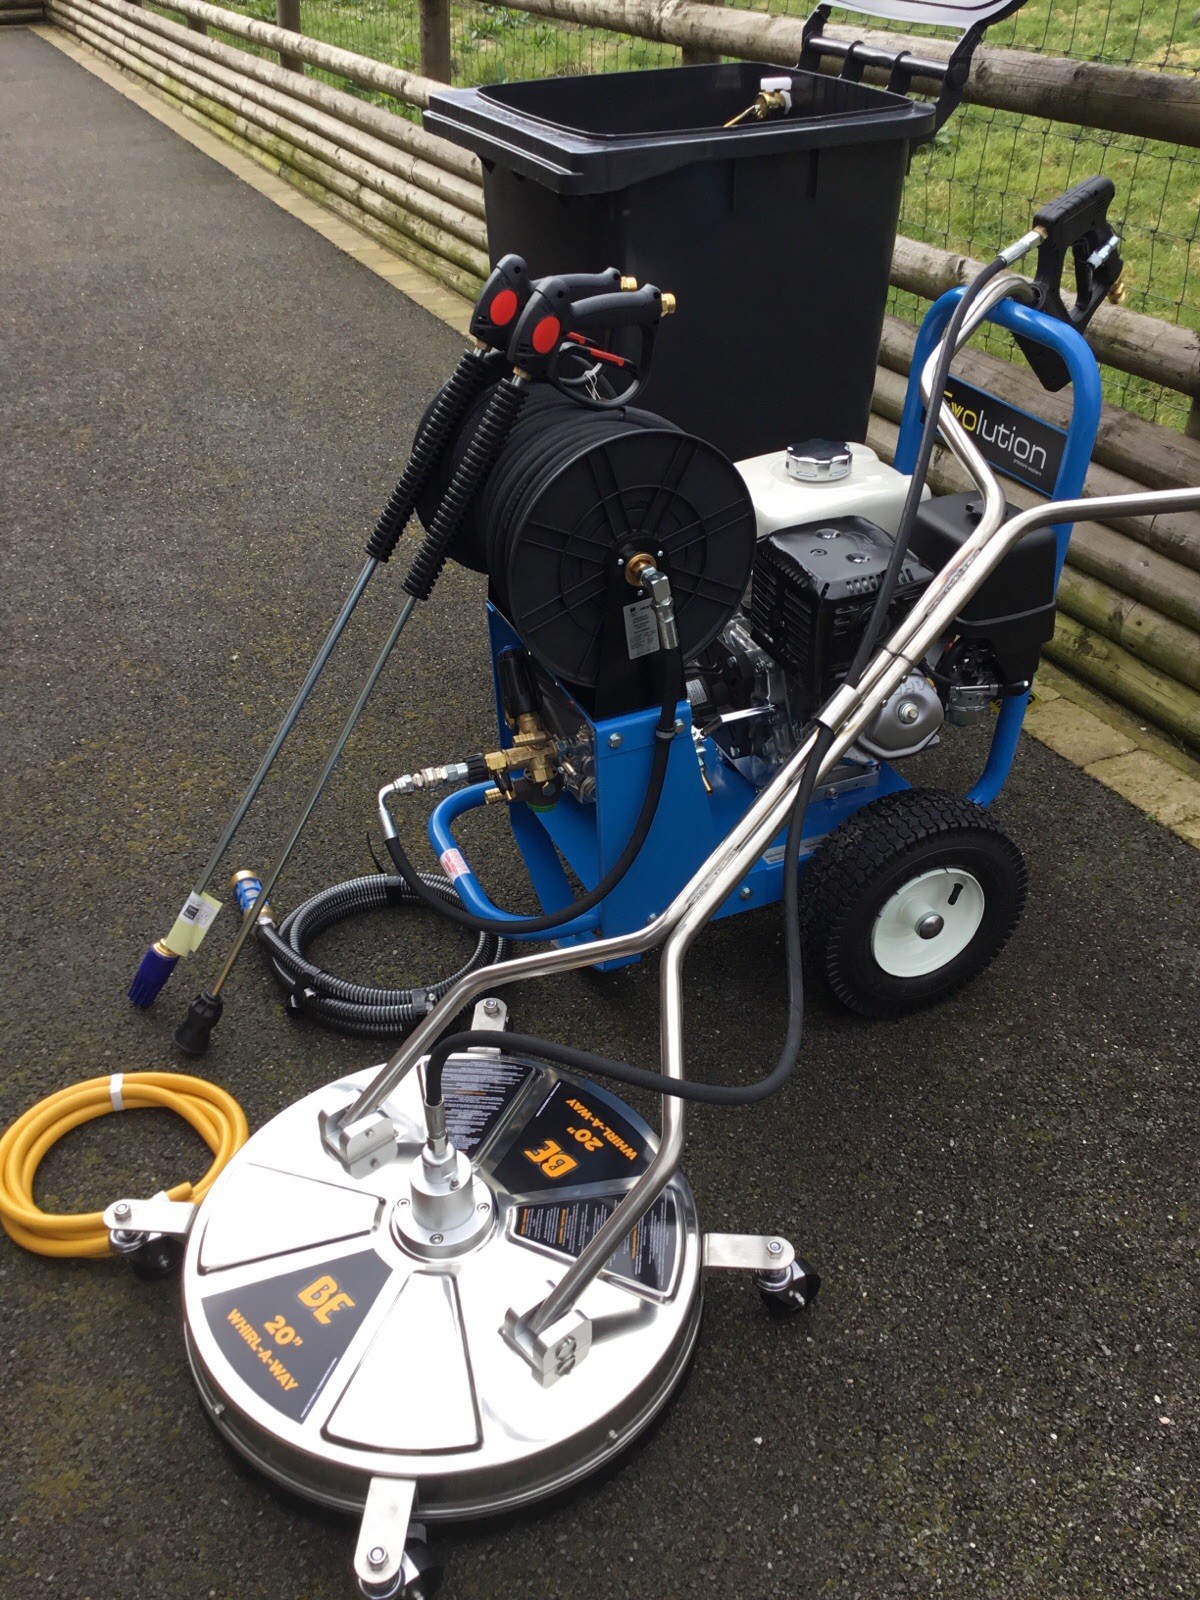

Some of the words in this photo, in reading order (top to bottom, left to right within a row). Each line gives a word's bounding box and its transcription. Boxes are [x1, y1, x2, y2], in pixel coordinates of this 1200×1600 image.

[944, 390, 1047, 470] volution
[523, 1139, 580, 1179] BE
[566, 1098, 638, 1161] WHIRL-A-WAY
[297, 1274, 356, 1325] BE
[226, 1308, 299, 1391] WHIRL-A-WAY
